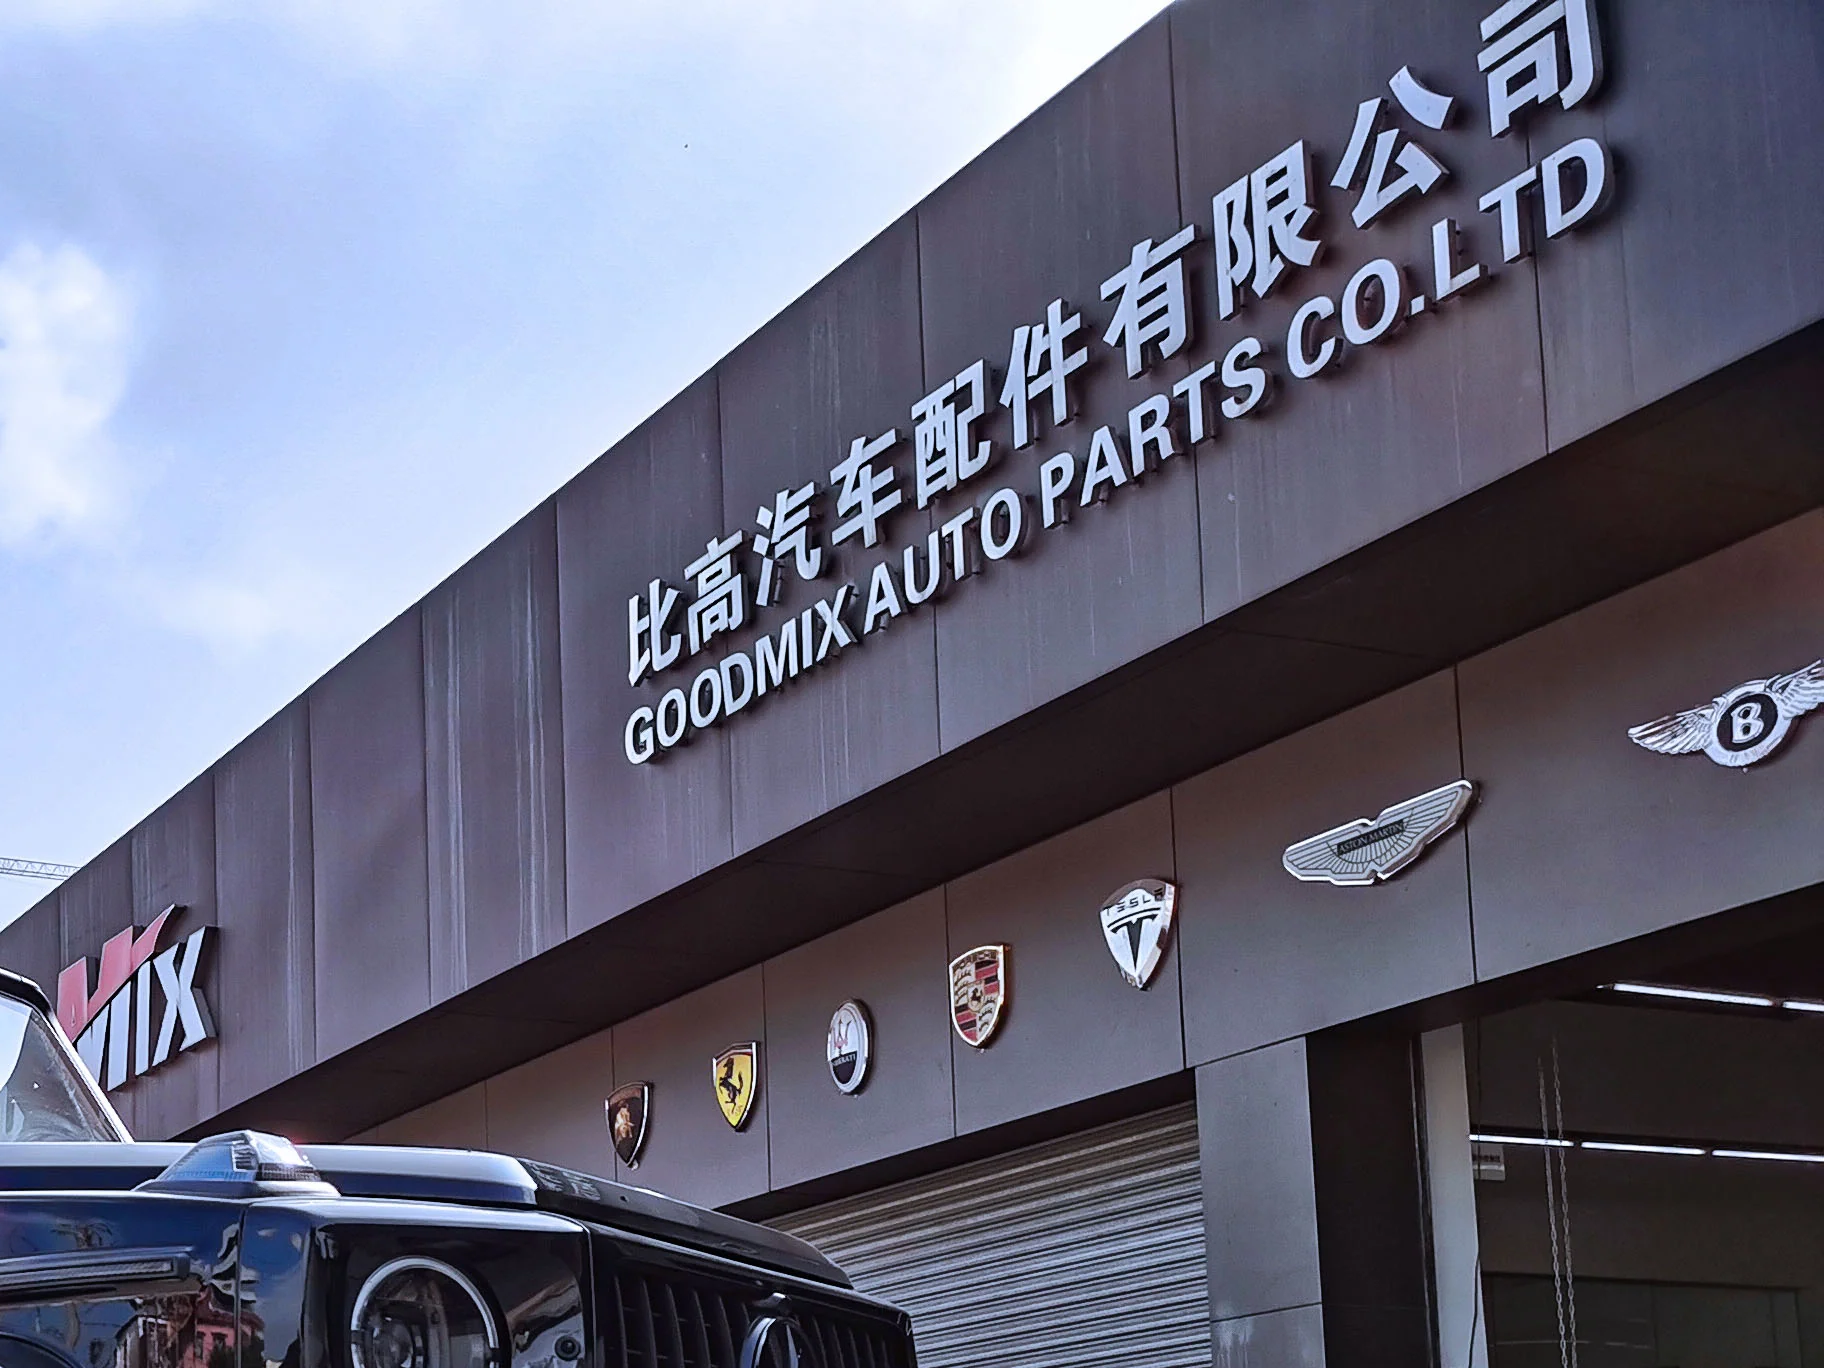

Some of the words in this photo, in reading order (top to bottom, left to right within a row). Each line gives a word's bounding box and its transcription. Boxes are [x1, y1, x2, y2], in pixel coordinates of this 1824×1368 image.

[623, 584, 854, 766] GOODMIX
[862, 487, 1023, 636] AUTO
[1039, 336, 1268, 530] PARTS
[627, 0, 1598, 690] 比高汽车配件有限公司
[1103, 887, 1164, 917] TESLA
